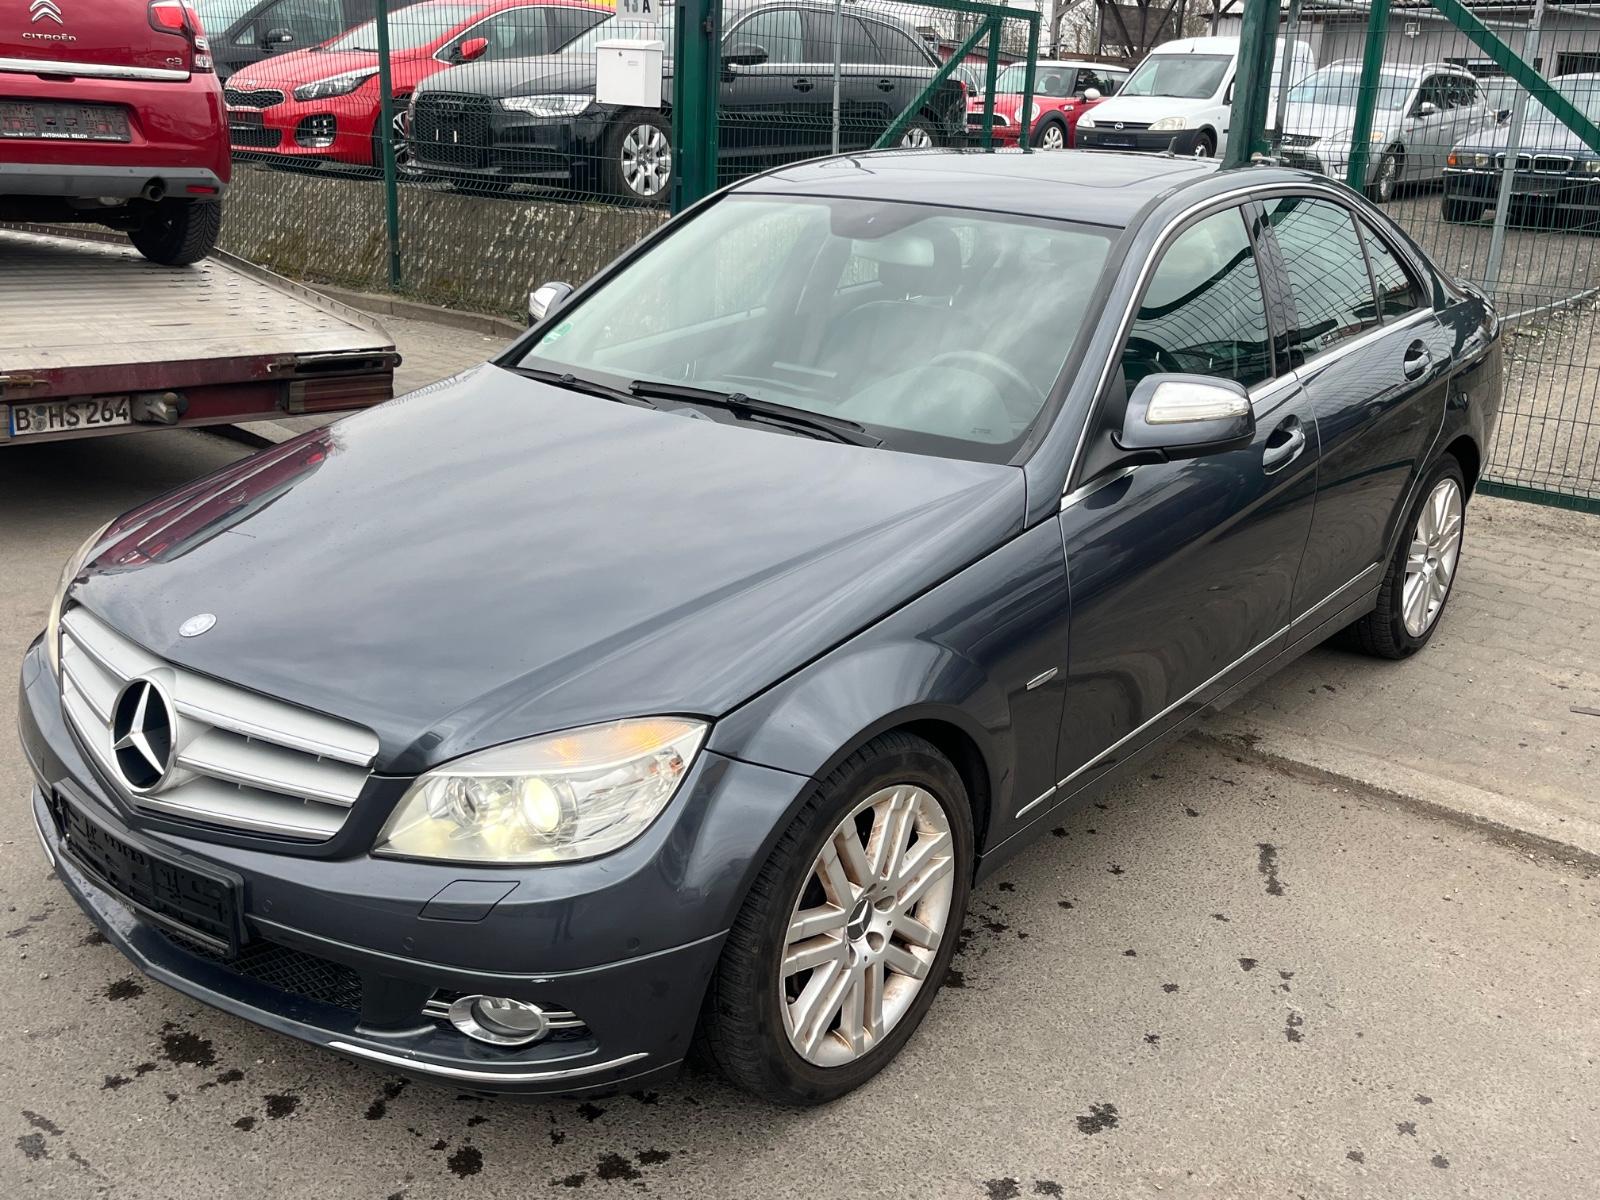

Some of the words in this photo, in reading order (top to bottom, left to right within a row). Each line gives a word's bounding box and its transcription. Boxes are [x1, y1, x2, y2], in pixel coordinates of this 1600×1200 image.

[643, 0, 651, 13] A
[22, 32, 77, 41] CITROËN
[166, 57, 182, 65] C3
[15, 408, 31, 431] B
[48, 403, 80, 428] HS
[86, 398, 128, 424] 264
